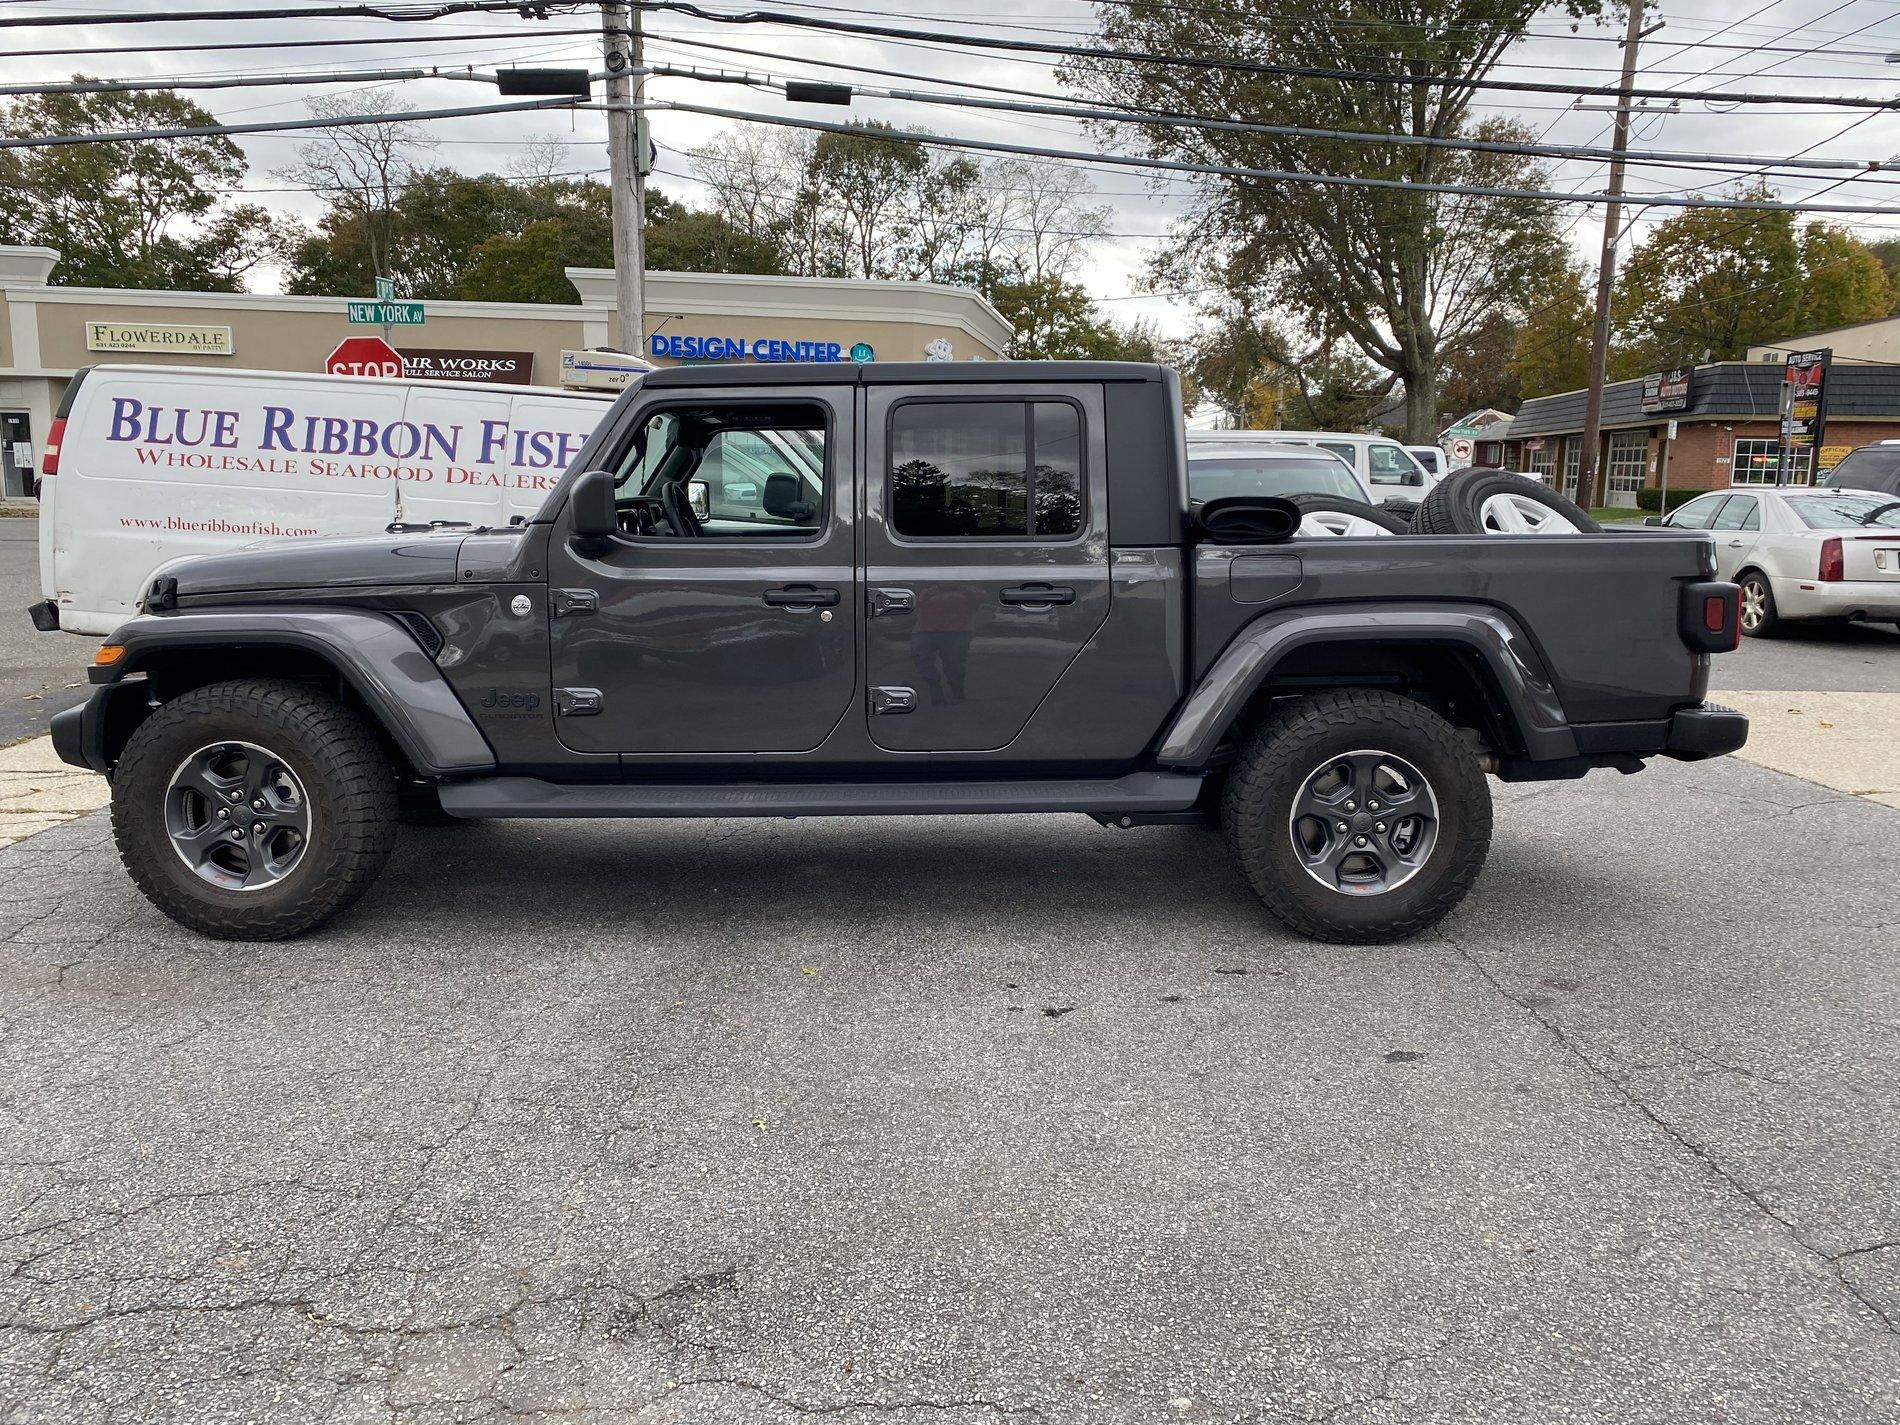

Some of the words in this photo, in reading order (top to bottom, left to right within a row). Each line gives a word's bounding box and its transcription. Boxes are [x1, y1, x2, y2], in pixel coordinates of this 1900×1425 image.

[349, 304, 375, 322] NEW
[379, 305, 411, 322] YORK
[413, 311, 423, 322] AV
[94, 325, 224, 345] FLOWERDALE
[651, 335, 746, 360] DESIGN
[752, 339, 841, 362] CENTER
[332, 361, 398, 377] STOP
[402, 357, 434, 369] AIR
[438, 358, 516, 371] WORKS
[1788, 354, 1801, 365] AUTO
[424, 369, 461, 377] SERVICE
[106, 397, 240, 449] BLUE
[257, 406, 463, 463] RIBBON
[475, 419, 591, 469] FISH
[134, 447, 298, 475] WHOLESALE
[309, 458, 434, 482] SEAFOOD
[444, 466, 560, 490] DEALERS
[120, 516, 318, 537] www.blueribbonfish.com
[480, 689, 540, 711] Jeep
